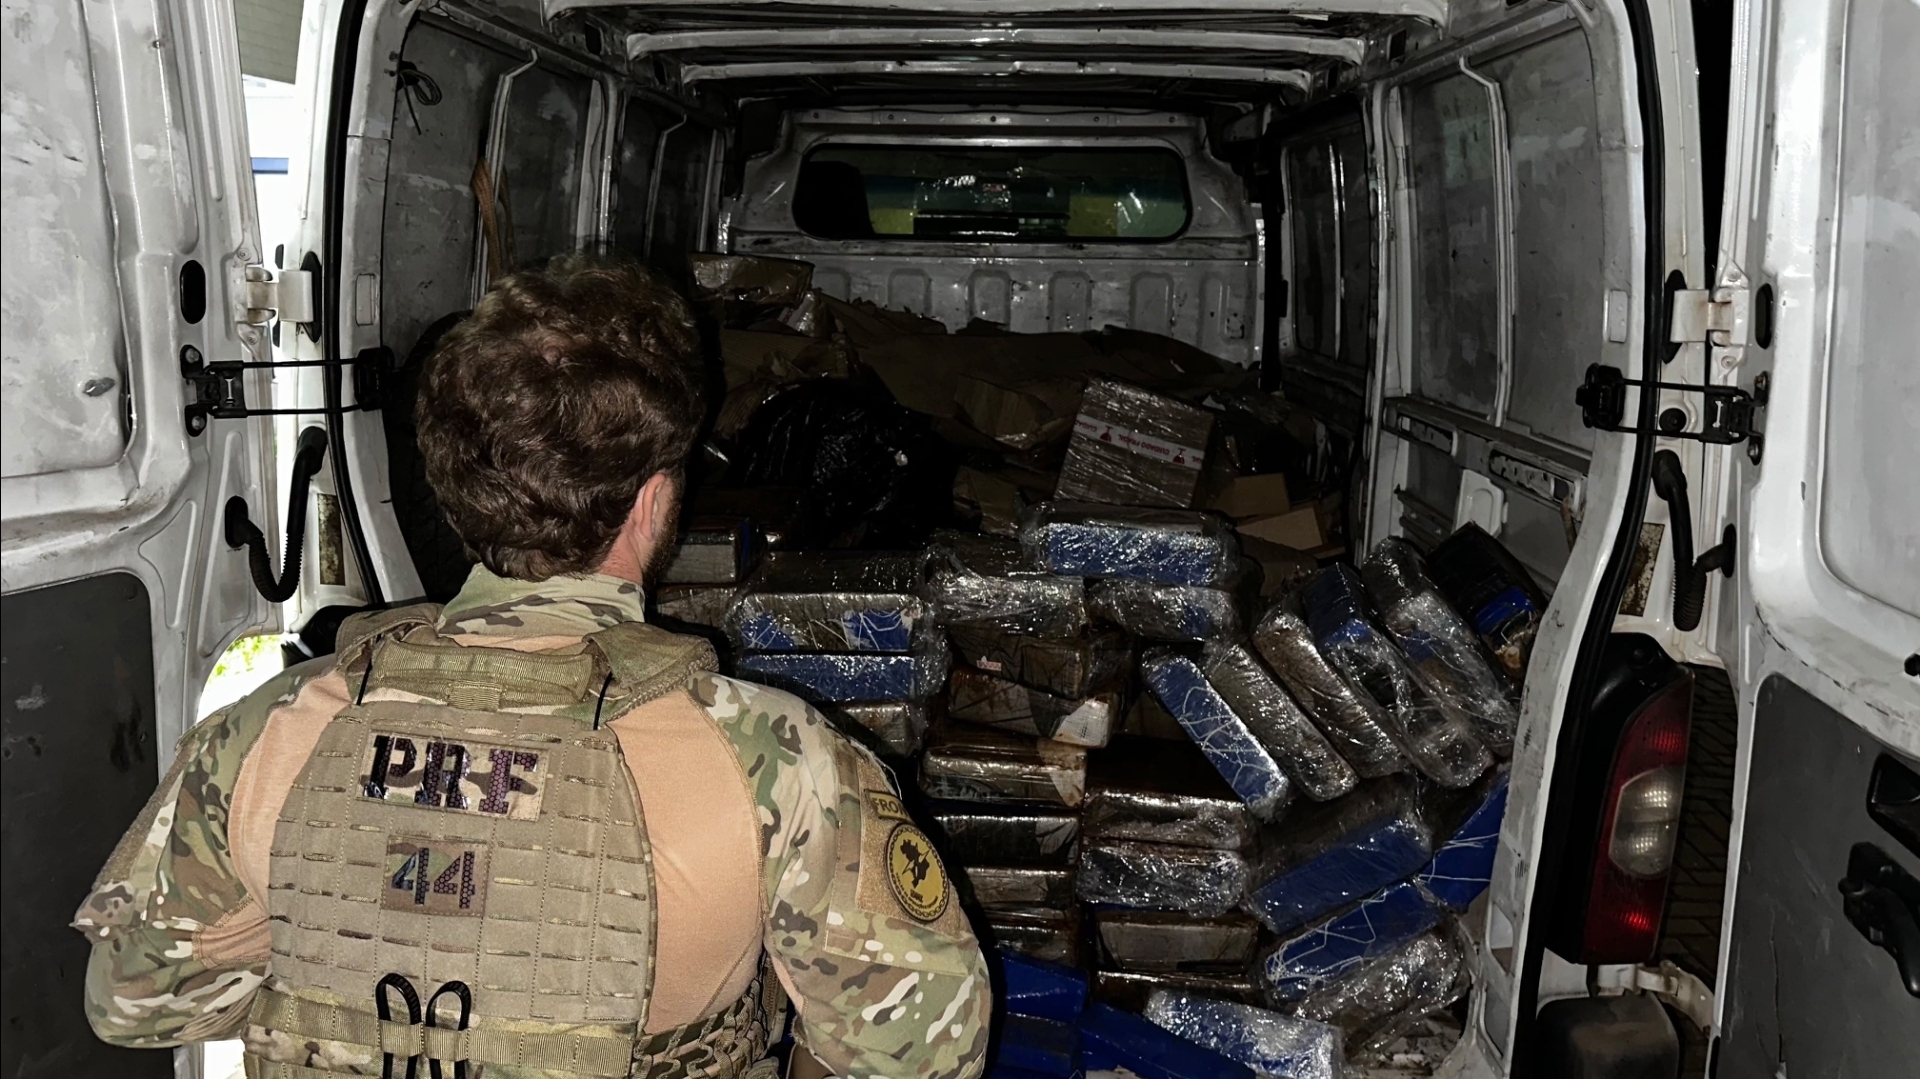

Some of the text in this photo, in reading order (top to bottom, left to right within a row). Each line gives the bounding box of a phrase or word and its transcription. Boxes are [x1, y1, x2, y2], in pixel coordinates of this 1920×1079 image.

[1141, 441, 1170, 455] CUIDADO
[363, 735, 539, 814] PRF
[391, 848, 476, 909] 44
